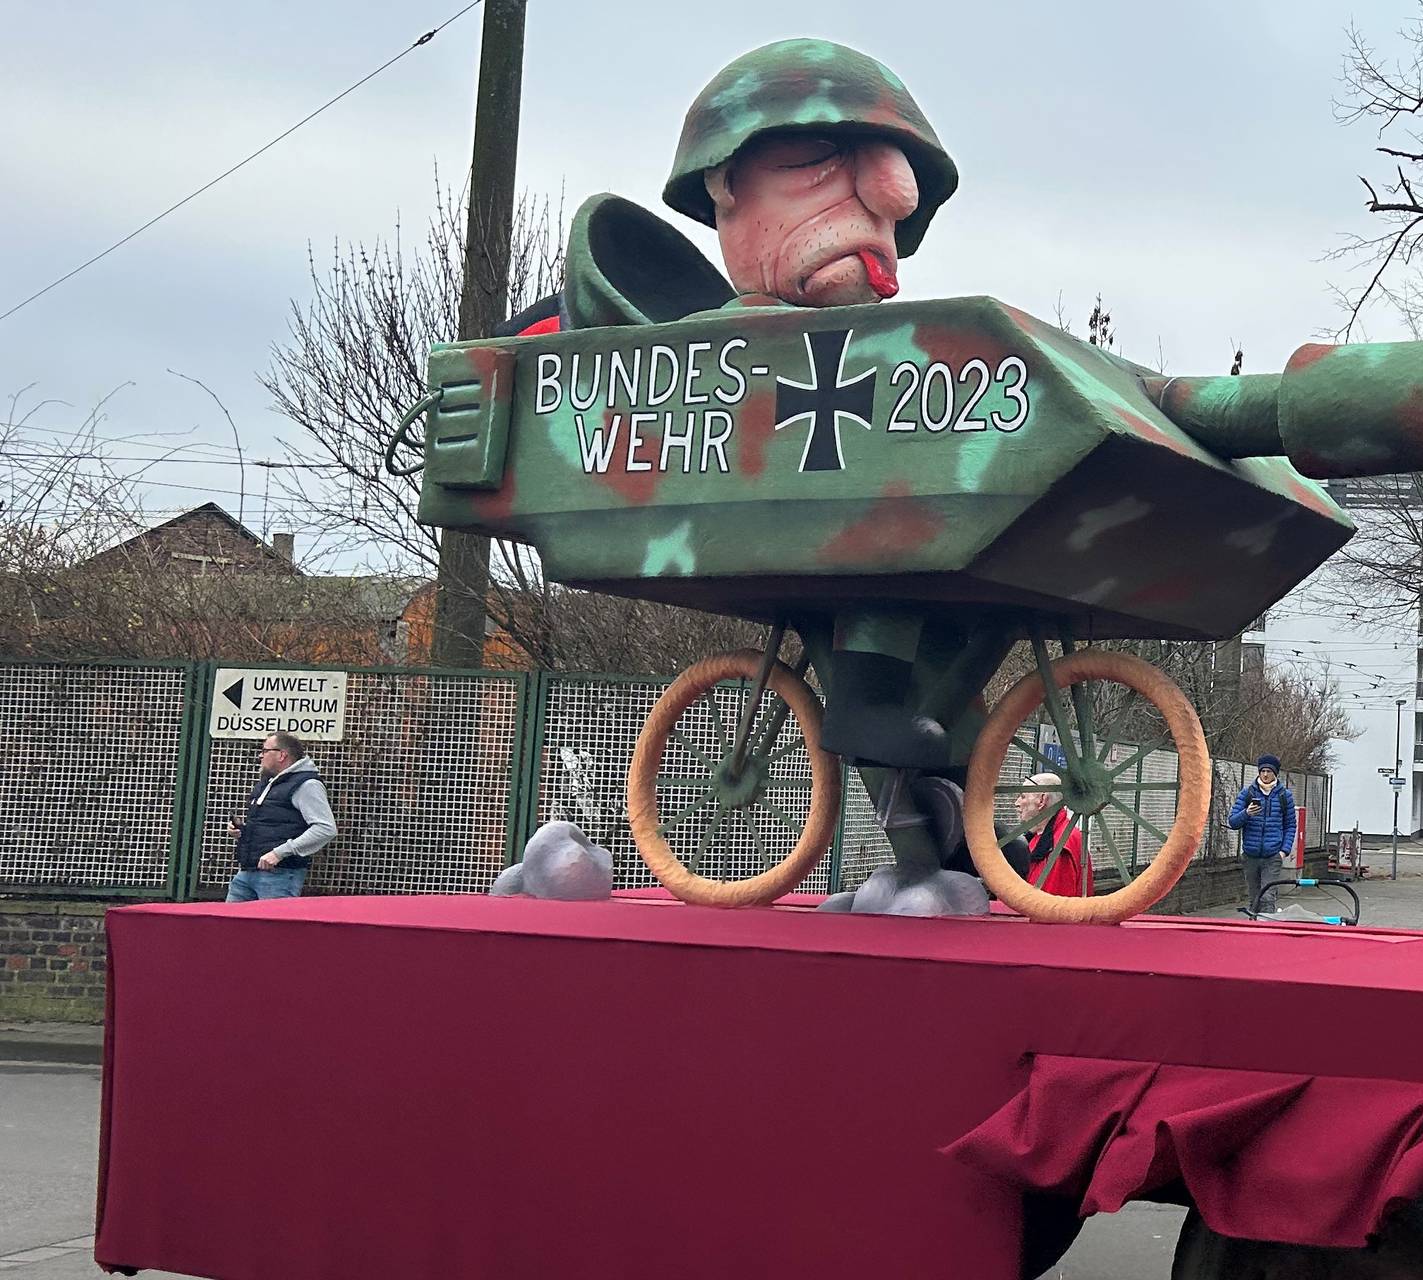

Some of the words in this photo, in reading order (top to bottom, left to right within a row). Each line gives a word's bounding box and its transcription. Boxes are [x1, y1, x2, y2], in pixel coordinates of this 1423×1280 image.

[535, 338, 770, 415] BUNDES-
[886, 355, 1030, 434] 2023
[573, 410, 734, 474] WEHR
[252, 697, 338, 713] ZENTRUM
[254, 677, 327, 692] UMWELT
[217, 713, 336, 733] DÜSSELDORF
